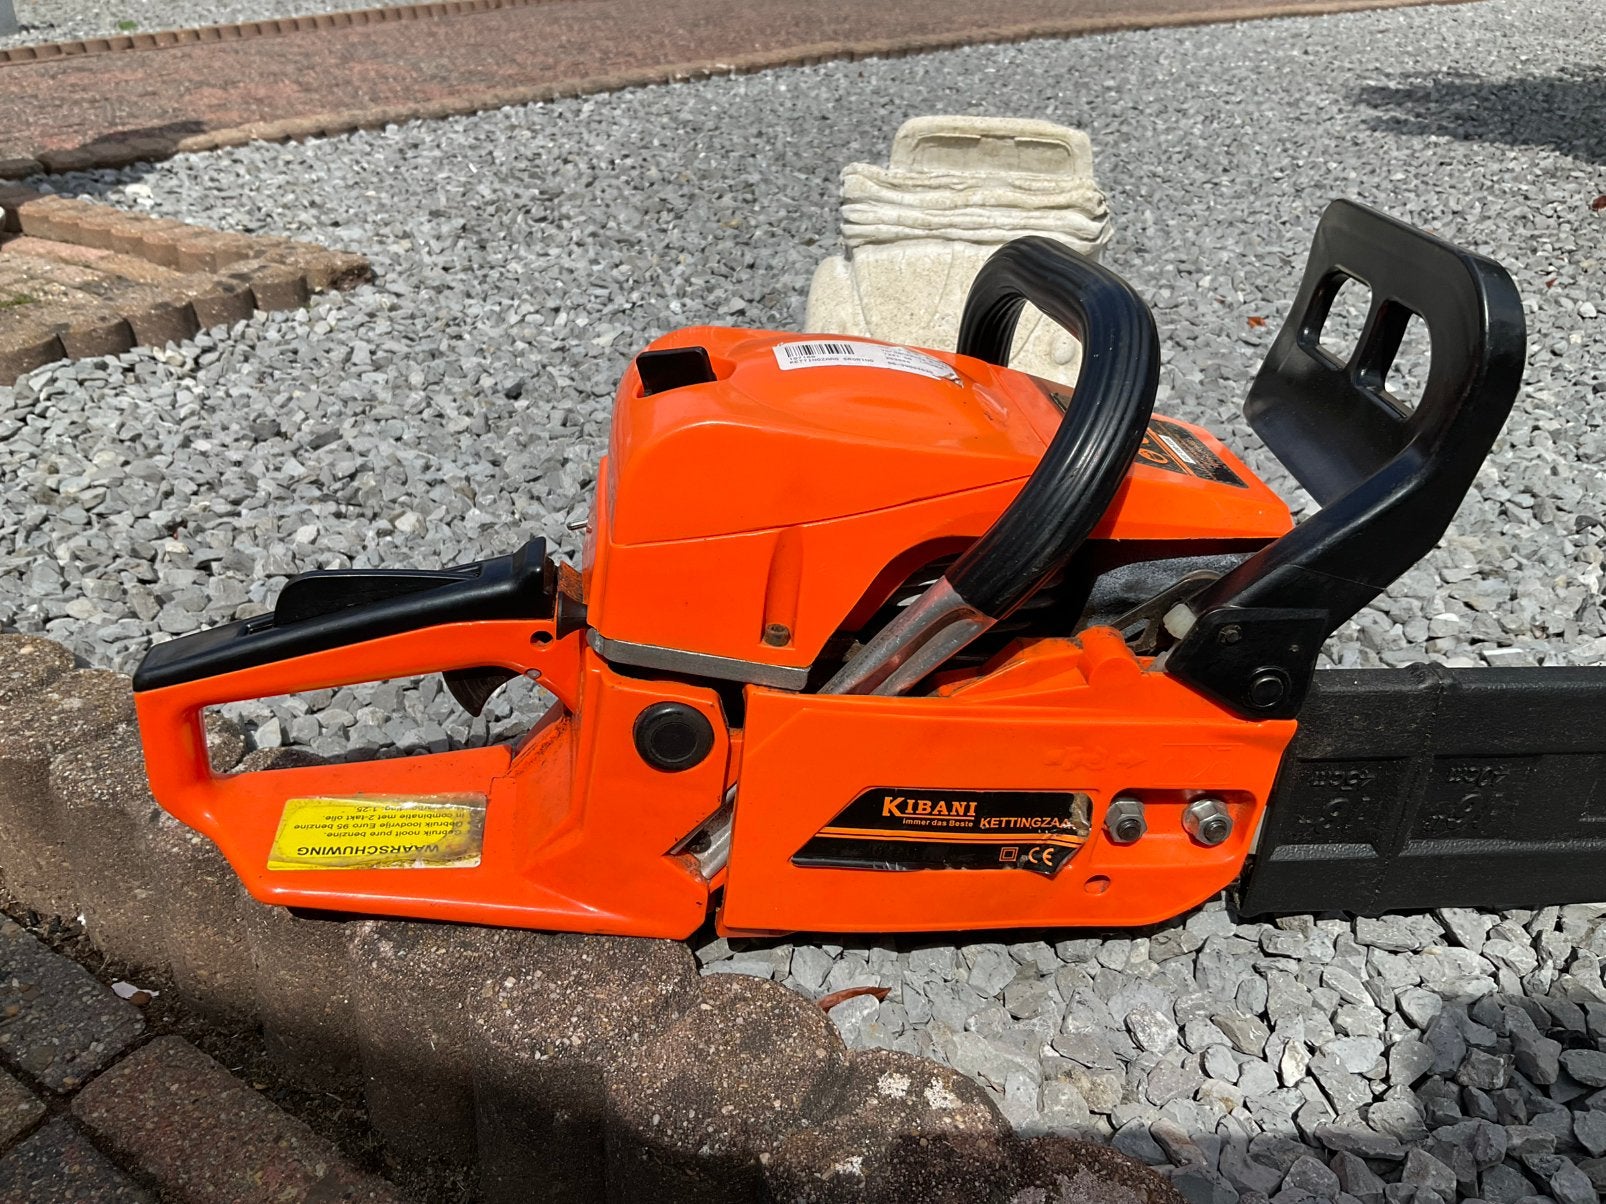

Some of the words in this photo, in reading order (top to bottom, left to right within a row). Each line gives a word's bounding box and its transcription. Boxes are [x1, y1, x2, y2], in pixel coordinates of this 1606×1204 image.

[882, 797, 977, 816] KIBANI
[379, 821, 422, 829] loodvrije
[980, 817, 1073, 829] KETTINGZAA
[297, 844, 439, 856] WAARSCHUWING
